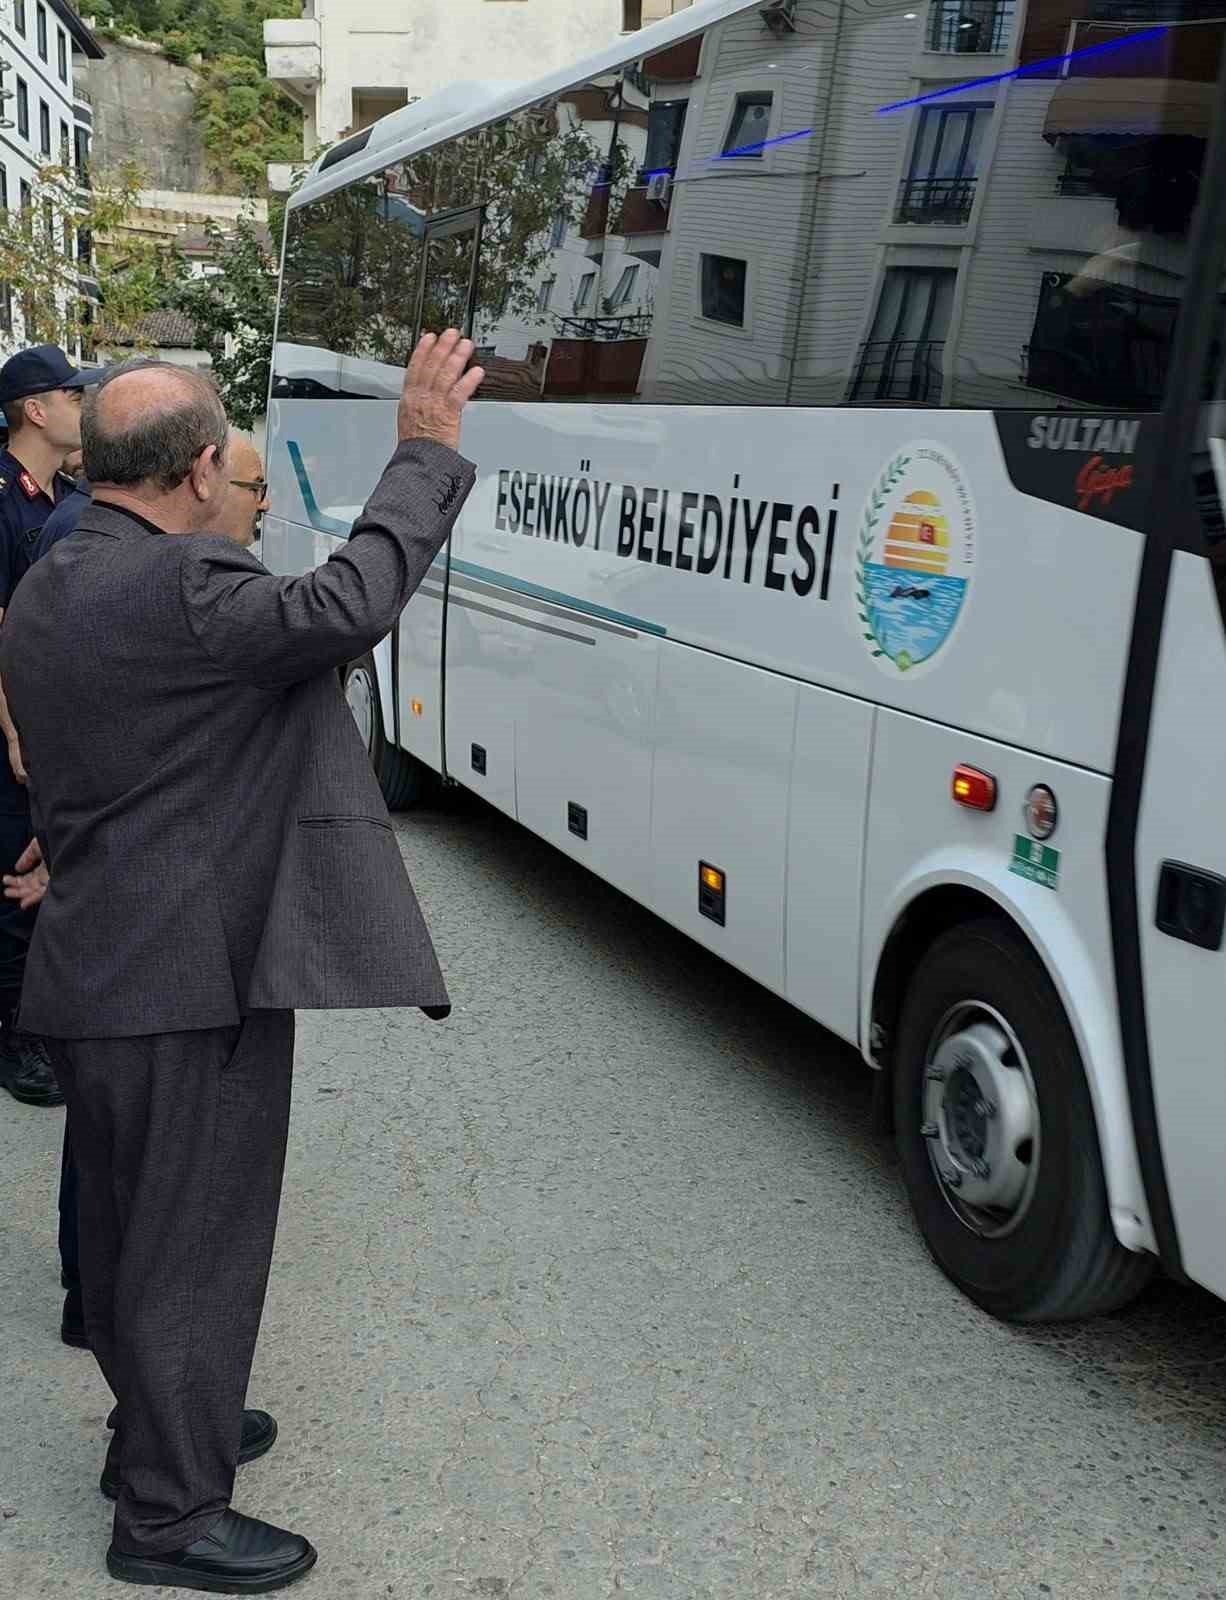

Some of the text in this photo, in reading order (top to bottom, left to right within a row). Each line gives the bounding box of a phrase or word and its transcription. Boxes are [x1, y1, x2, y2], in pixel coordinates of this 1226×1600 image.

[1026, 415, 1141, 454] SULTAN
[495, 459, 611, 551] ESENKÖY
[616, 473, 841, 601] BELEDİYESİ
